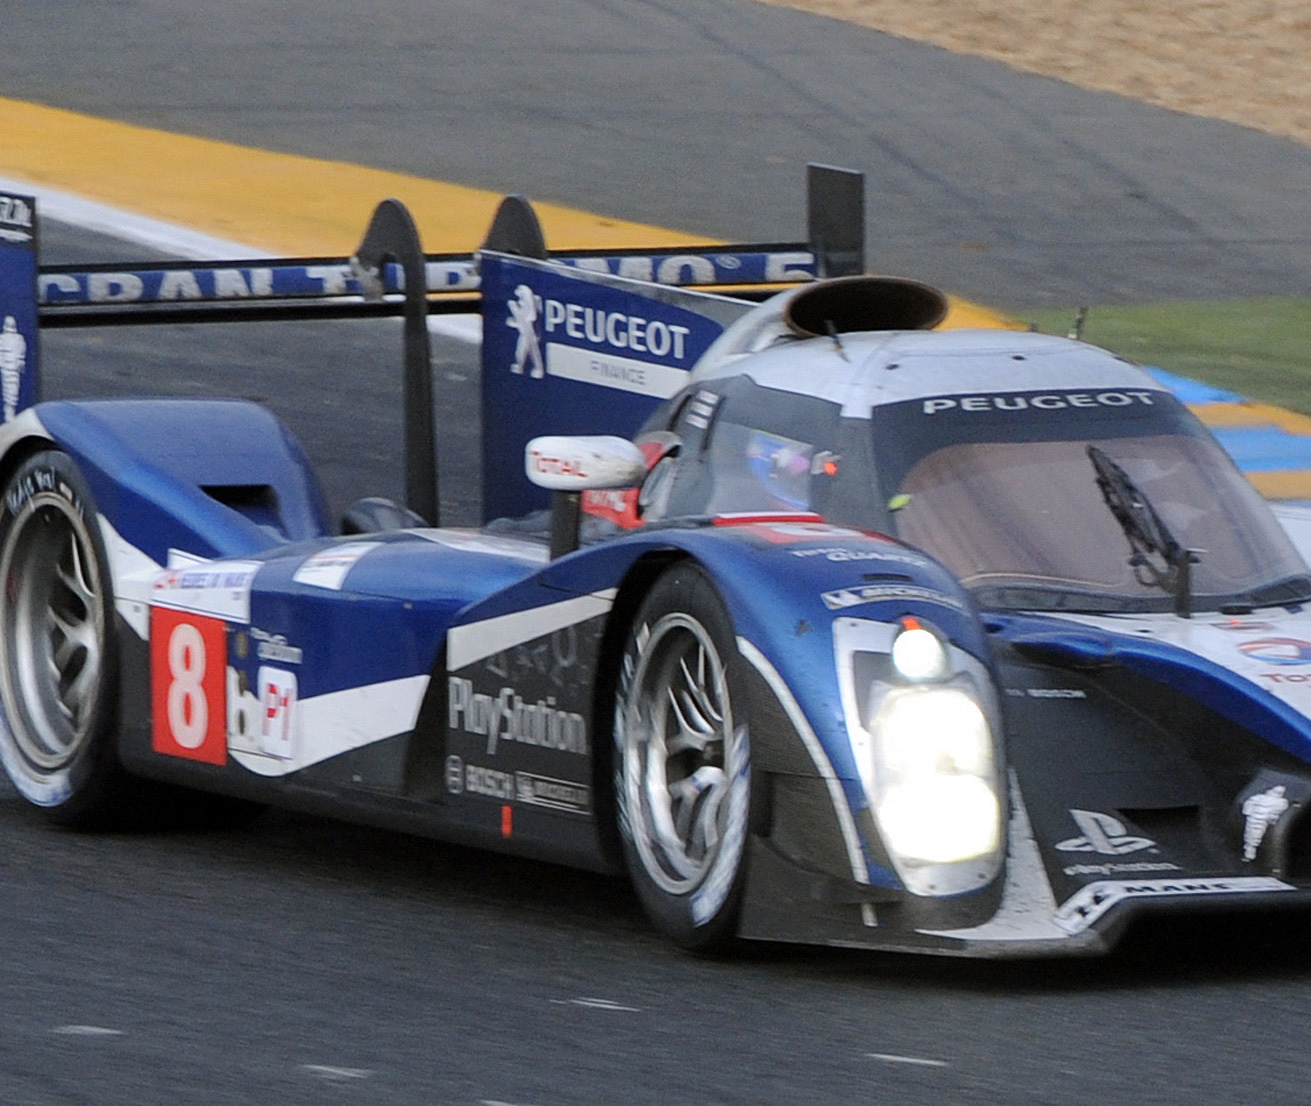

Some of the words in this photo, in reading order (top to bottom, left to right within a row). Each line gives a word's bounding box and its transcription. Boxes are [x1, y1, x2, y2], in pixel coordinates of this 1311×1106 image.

[38, 268, 275, 302] GRAN
[545, 300, 690, 360] PEUGEOT
[592, 359, 646, 386] FINANCE
[923, 392, 1153, 415] PEUGEOT
[167, 624, 209, 749] 8
[449, 676, 587, 755] PlayStation
